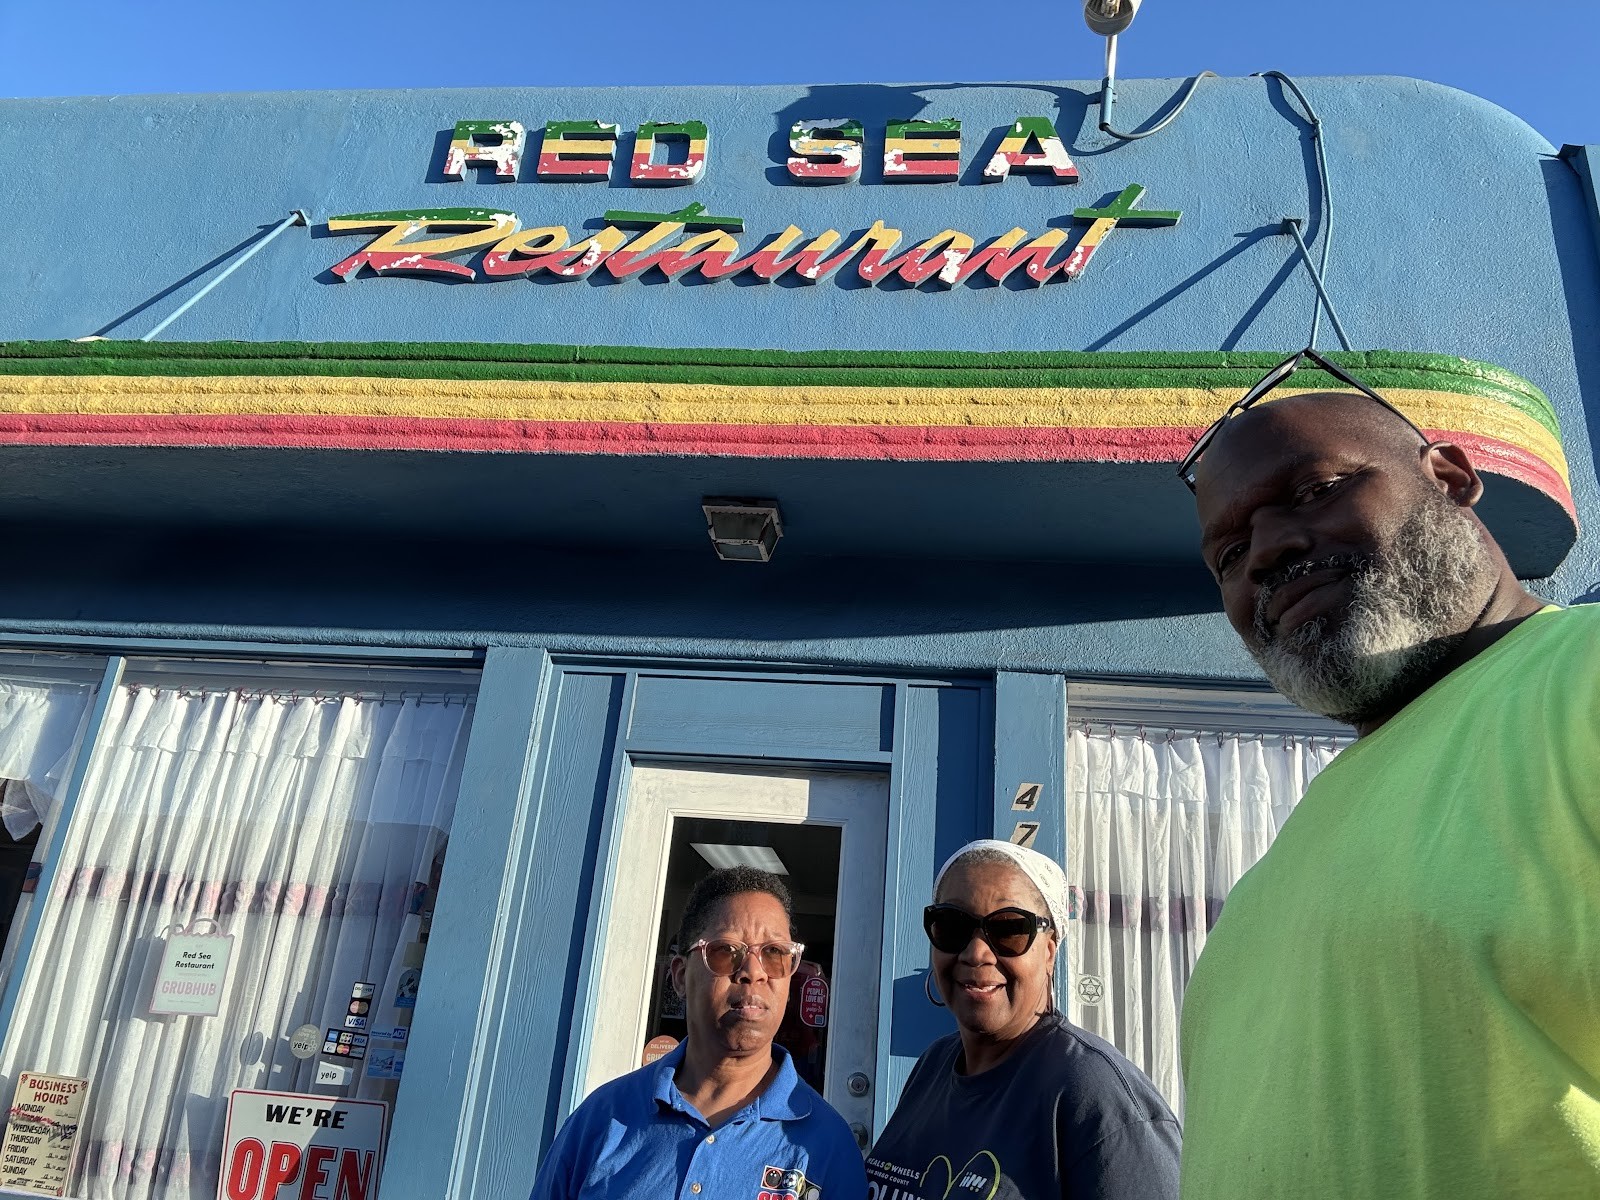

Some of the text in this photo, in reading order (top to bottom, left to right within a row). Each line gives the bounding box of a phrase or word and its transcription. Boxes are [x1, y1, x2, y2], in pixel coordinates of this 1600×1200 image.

[443, 116, 1079, 186] RED SEA
[327, 182, 1184, 288] Restaurant
[1015, 785, 1039, 809] 4
[1016, 824, 1038, 846] 7
[182, 951, 212, 960] Red Sea
[175, 960, 215, 970] Restaurant
[162, 981, 216, 996] GRUBHUB
[348, 1017, 365, 1026] VISA
[293, 1041, 309, 1051] yelp
[320, 1070, 337, 1080] yelp
[33, 1091, 69, 1105] HOURS
[17, 1102, 45, 1114] MONDAY
[265, 1104, 348, 1129] WE'RE
[10, 1133, 42, 1145] THURSDAY
[6, 1143, 29, 1154] FRIDAY
[4, 1154, 37, 1166] SATURDAY
[2, 1164, 28, 1175] SUNDAY
[225, 1137, 376, 1200] OPEN
[891, 1164, 920, 1180] WHEELS
